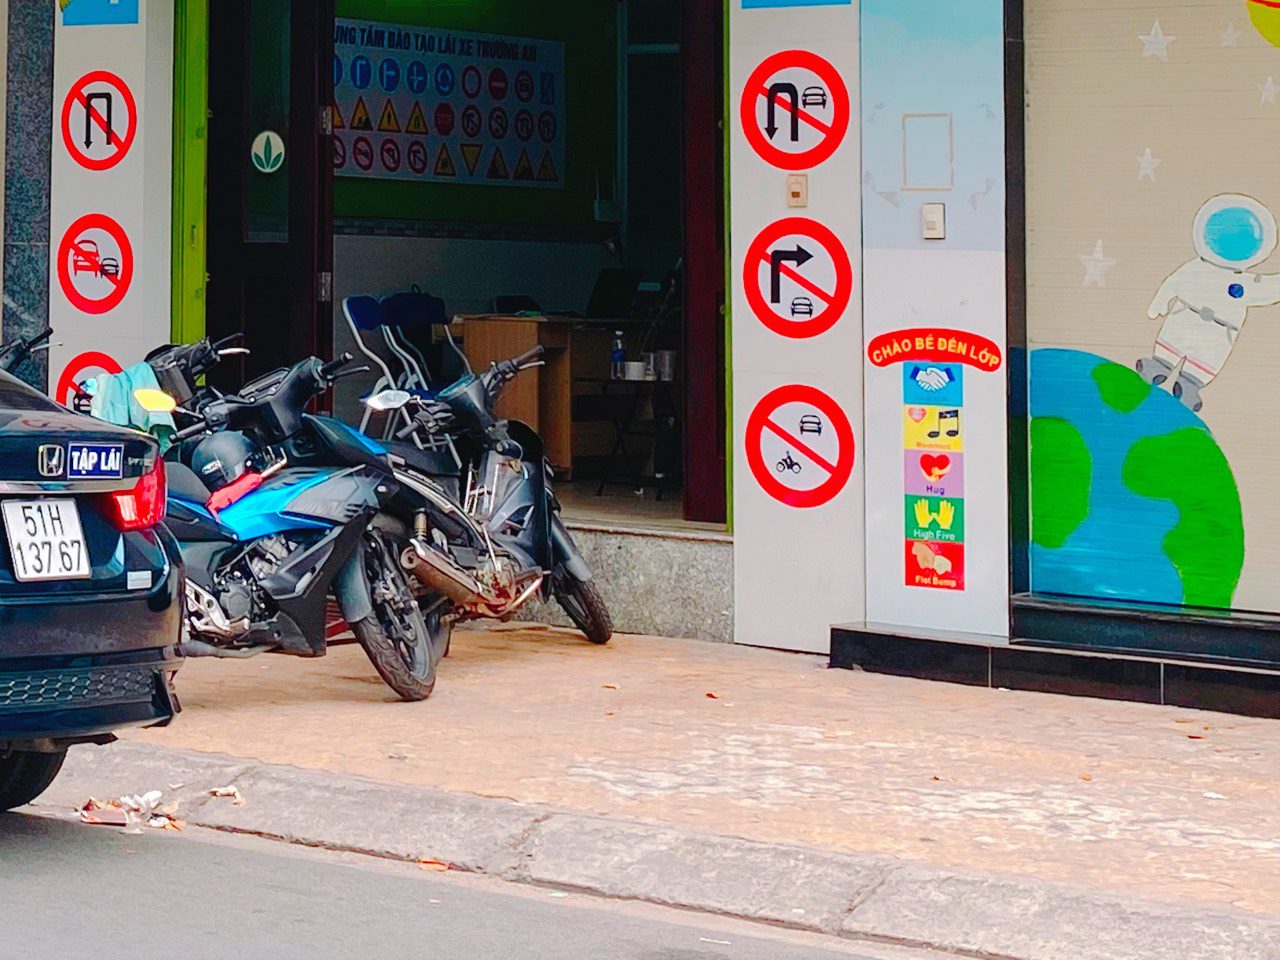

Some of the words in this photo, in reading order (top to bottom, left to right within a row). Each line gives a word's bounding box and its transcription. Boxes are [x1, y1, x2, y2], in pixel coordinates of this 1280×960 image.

[359, 25, 385, 49] TÂM
[873, 339, 912, 363] CHÀO
[915, 334, 935, 351] BÉ
[969, 346, 1000, 367] LỚP
[72, 447, 98, 474] TẬP
[100, 448, 120, 471] LÁI
[926, 485, 945, 496] Hug
[21, 504, 65, 537] 51H
[914, 529, 934, 540] High
[936, 530, 955, 540] Five
[16, 540, 81, 576] 137.67
